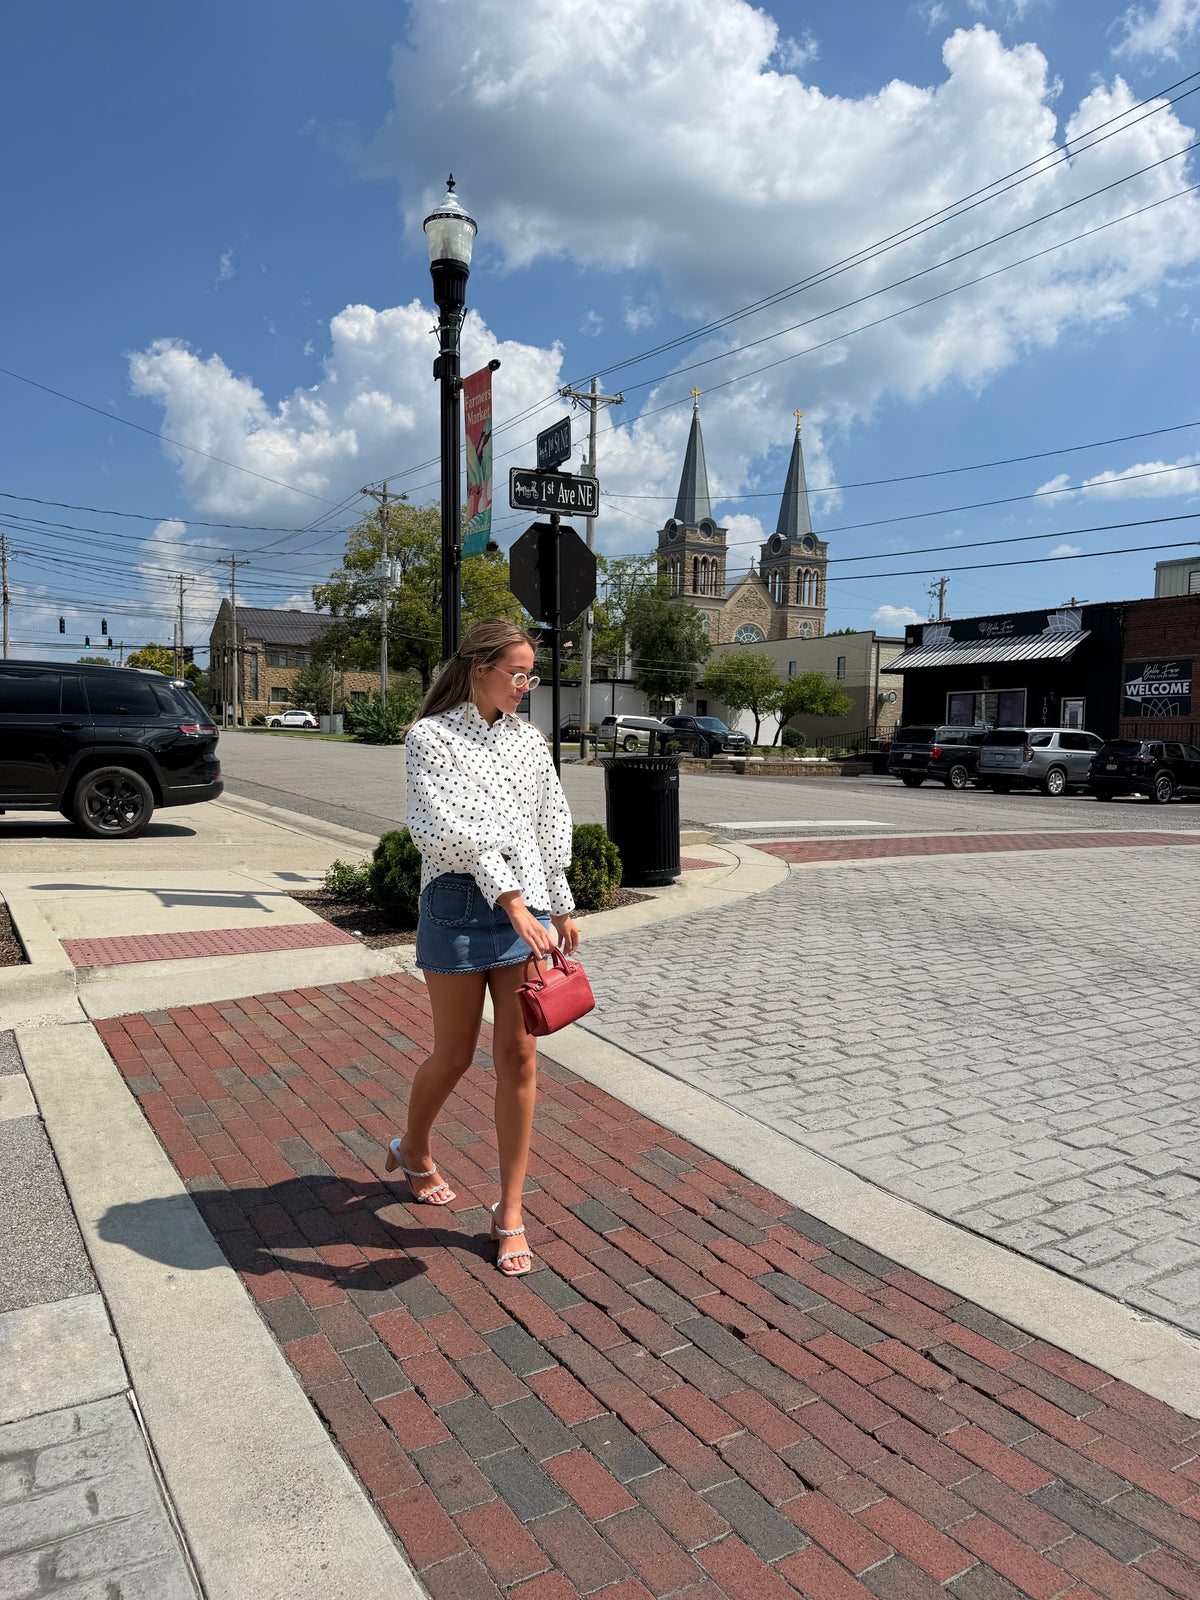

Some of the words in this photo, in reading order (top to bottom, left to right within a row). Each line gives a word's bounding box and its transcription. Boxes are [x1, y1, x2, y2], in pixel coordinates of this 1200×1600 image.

[467, 405, 490, 427] Market
[541, 481, 555, 502] 1st
[557, 482, 575, 505] Ave
[577, 484, 593, 507] NE
[1125, 682, 1190, 696] WELCOME
